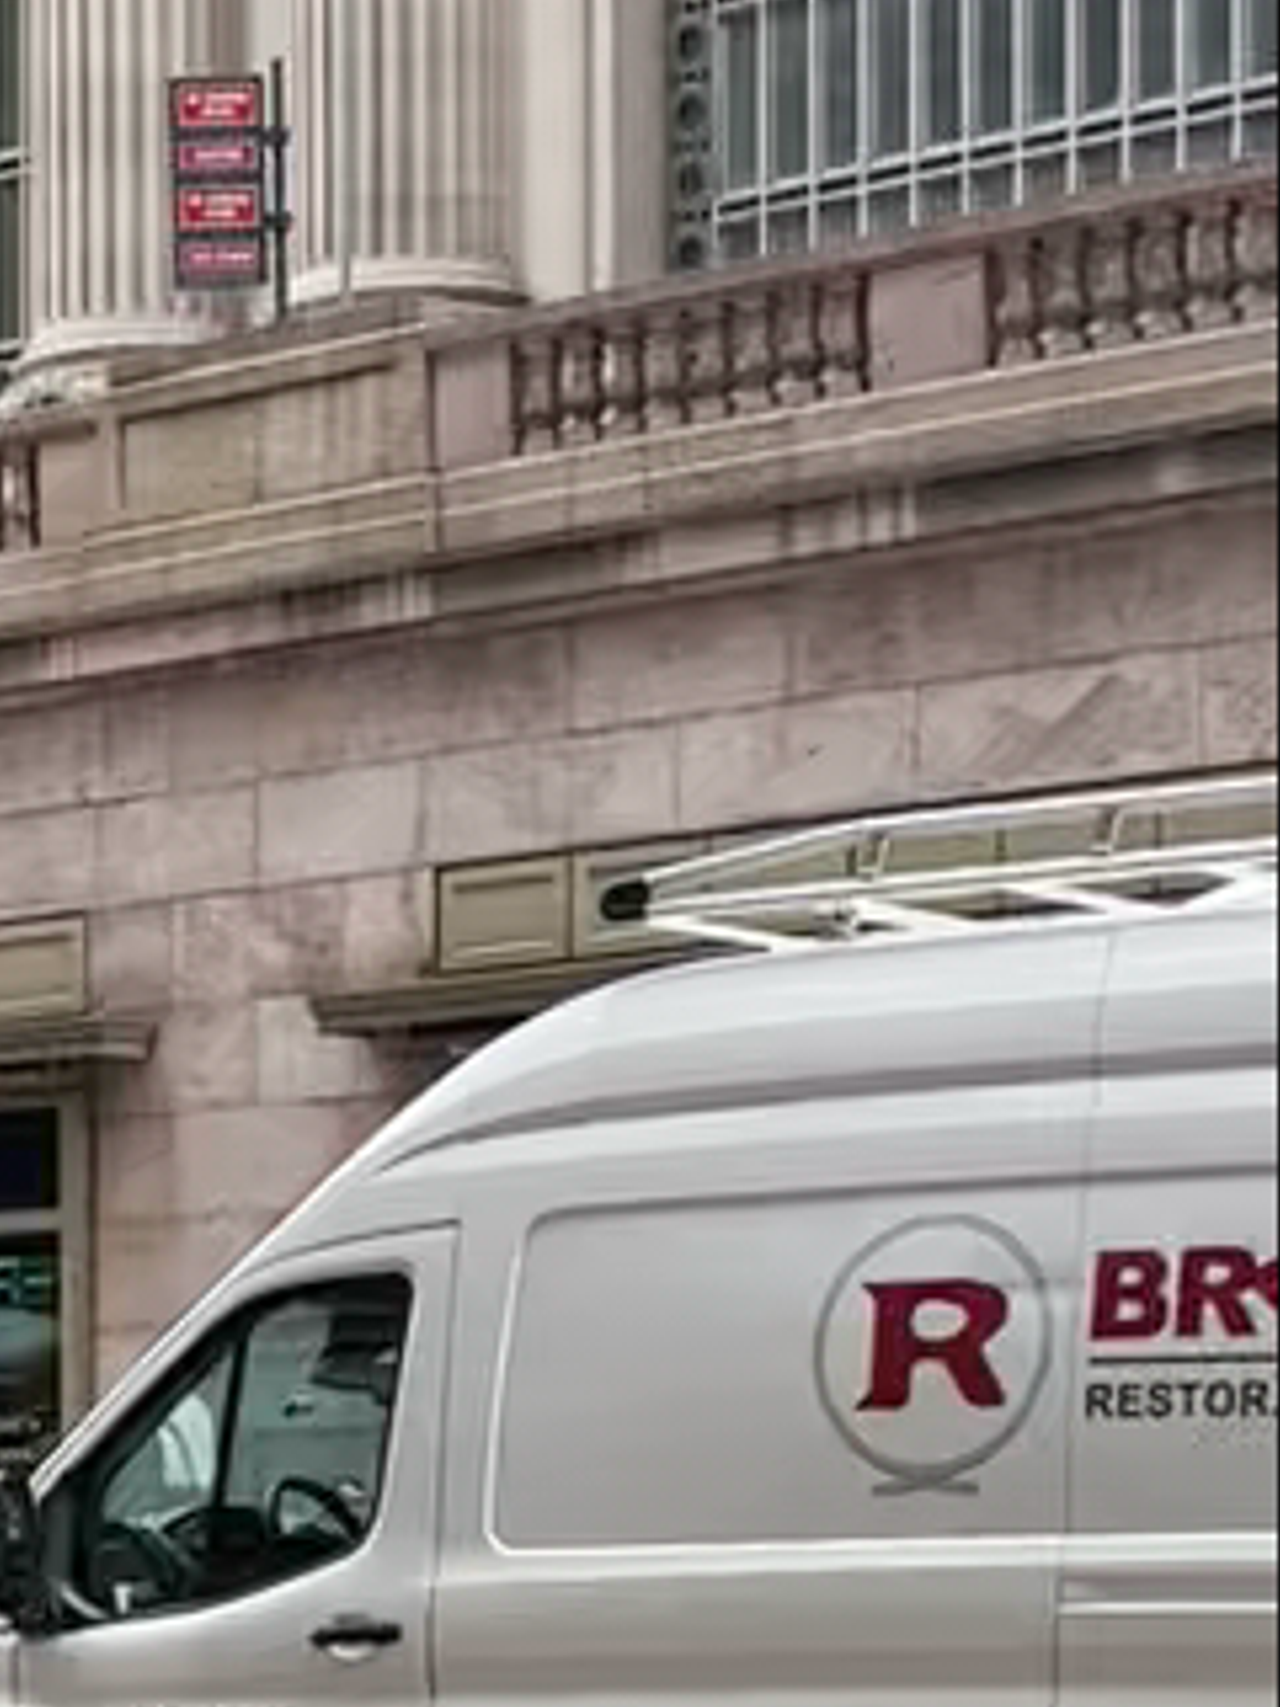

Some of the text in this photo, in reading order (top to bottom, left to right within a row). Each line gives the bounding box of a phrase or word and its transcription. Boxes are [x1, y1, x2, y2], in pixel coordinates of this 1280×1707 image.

[1089, 1246, 1278, 1342] BR
[855, 1278, 1008, 1411] R
[1085, 1380, 1278, 1420] RESTOR
